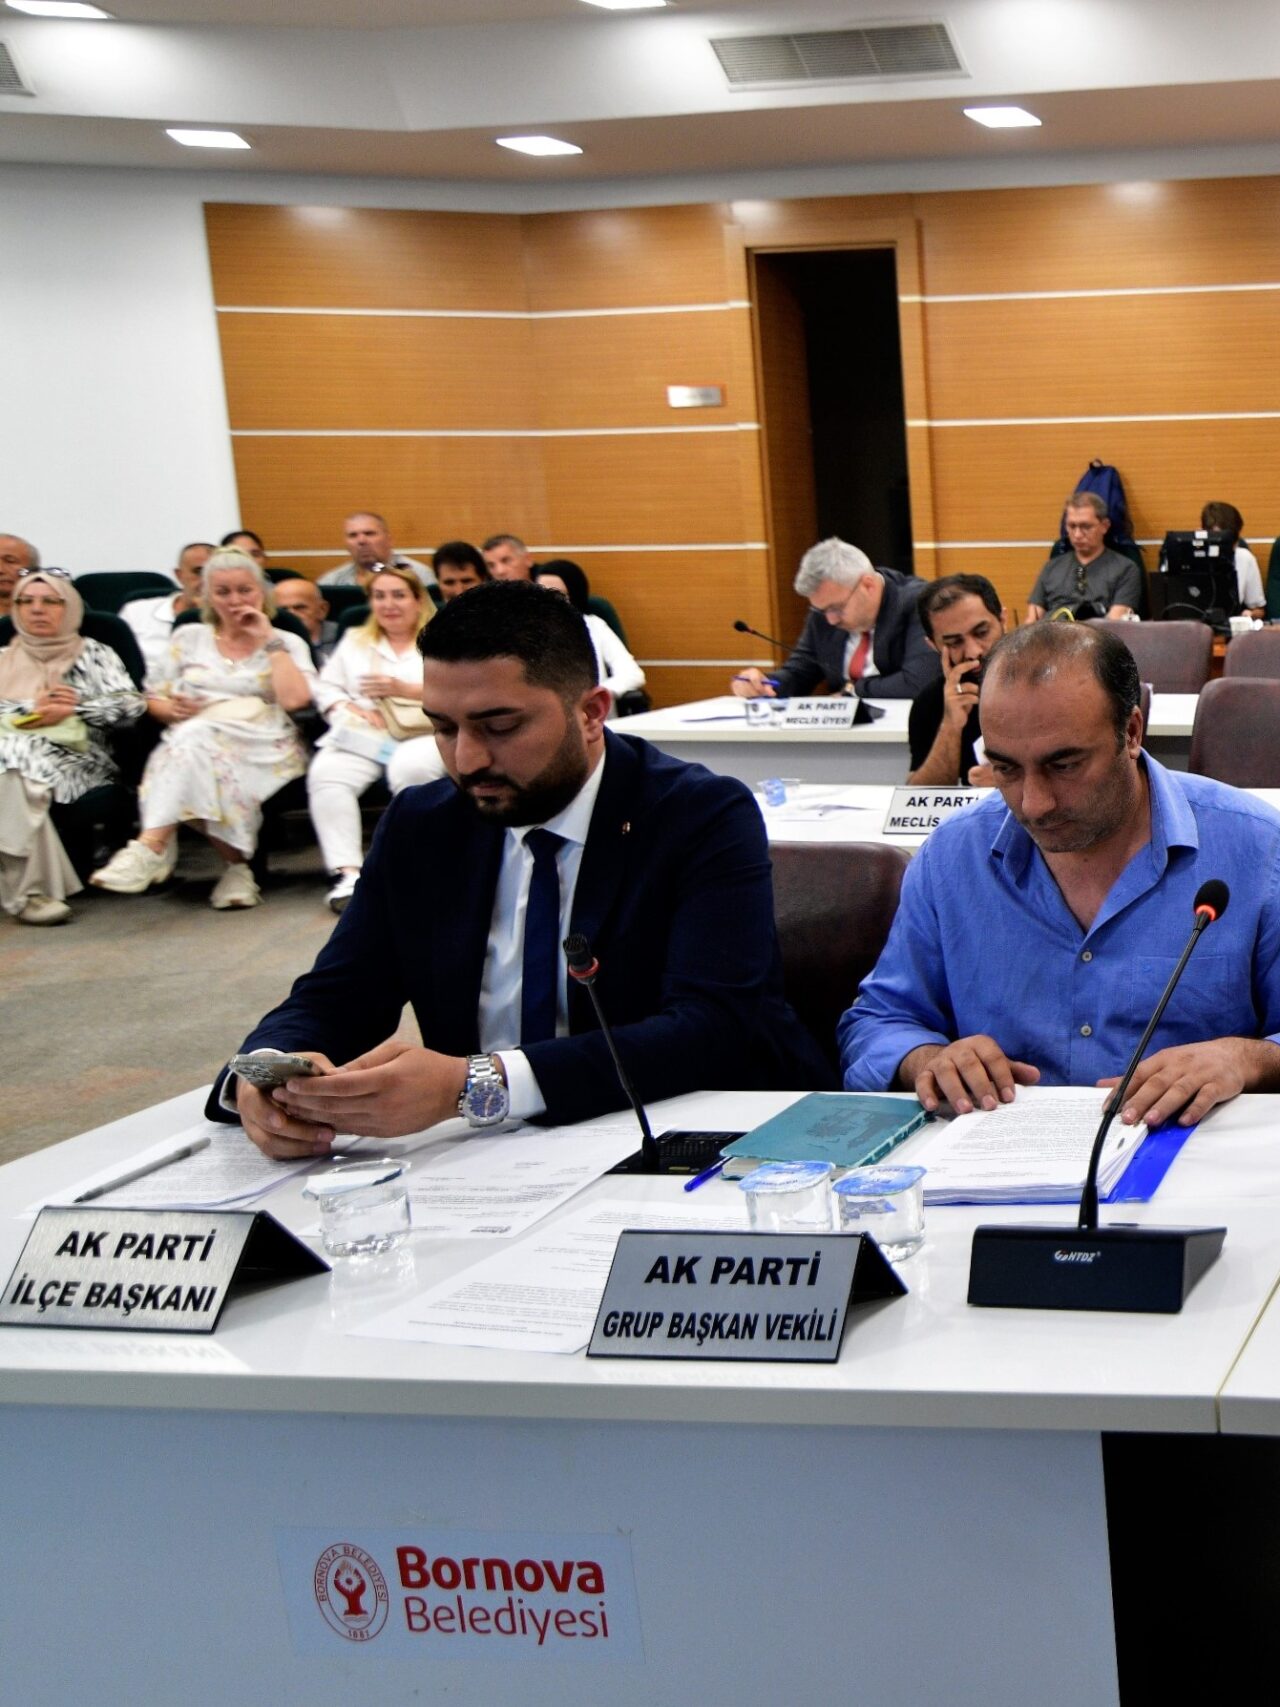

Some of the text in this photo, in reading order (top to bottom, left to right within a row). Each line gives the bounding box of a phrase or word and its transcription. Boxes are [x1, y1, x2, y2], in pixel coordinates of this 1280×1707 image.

[906, 796, 929, 807] AK
[890, 814, 940, 828] MECLİS
[55, 1228, 217, 1262] AK PARTİ
[644, 1250, 822, 1286] AK PARTİ
[10, 1272, 218, 1317] İLÇE BAŞKANI
[602, 1307, 838, 1346] GRUP BAŞKAN VEKİLİ
[396, 1545, 605, 1594] Bornova
[404, 1594, 609, 1646] Belediyesi
